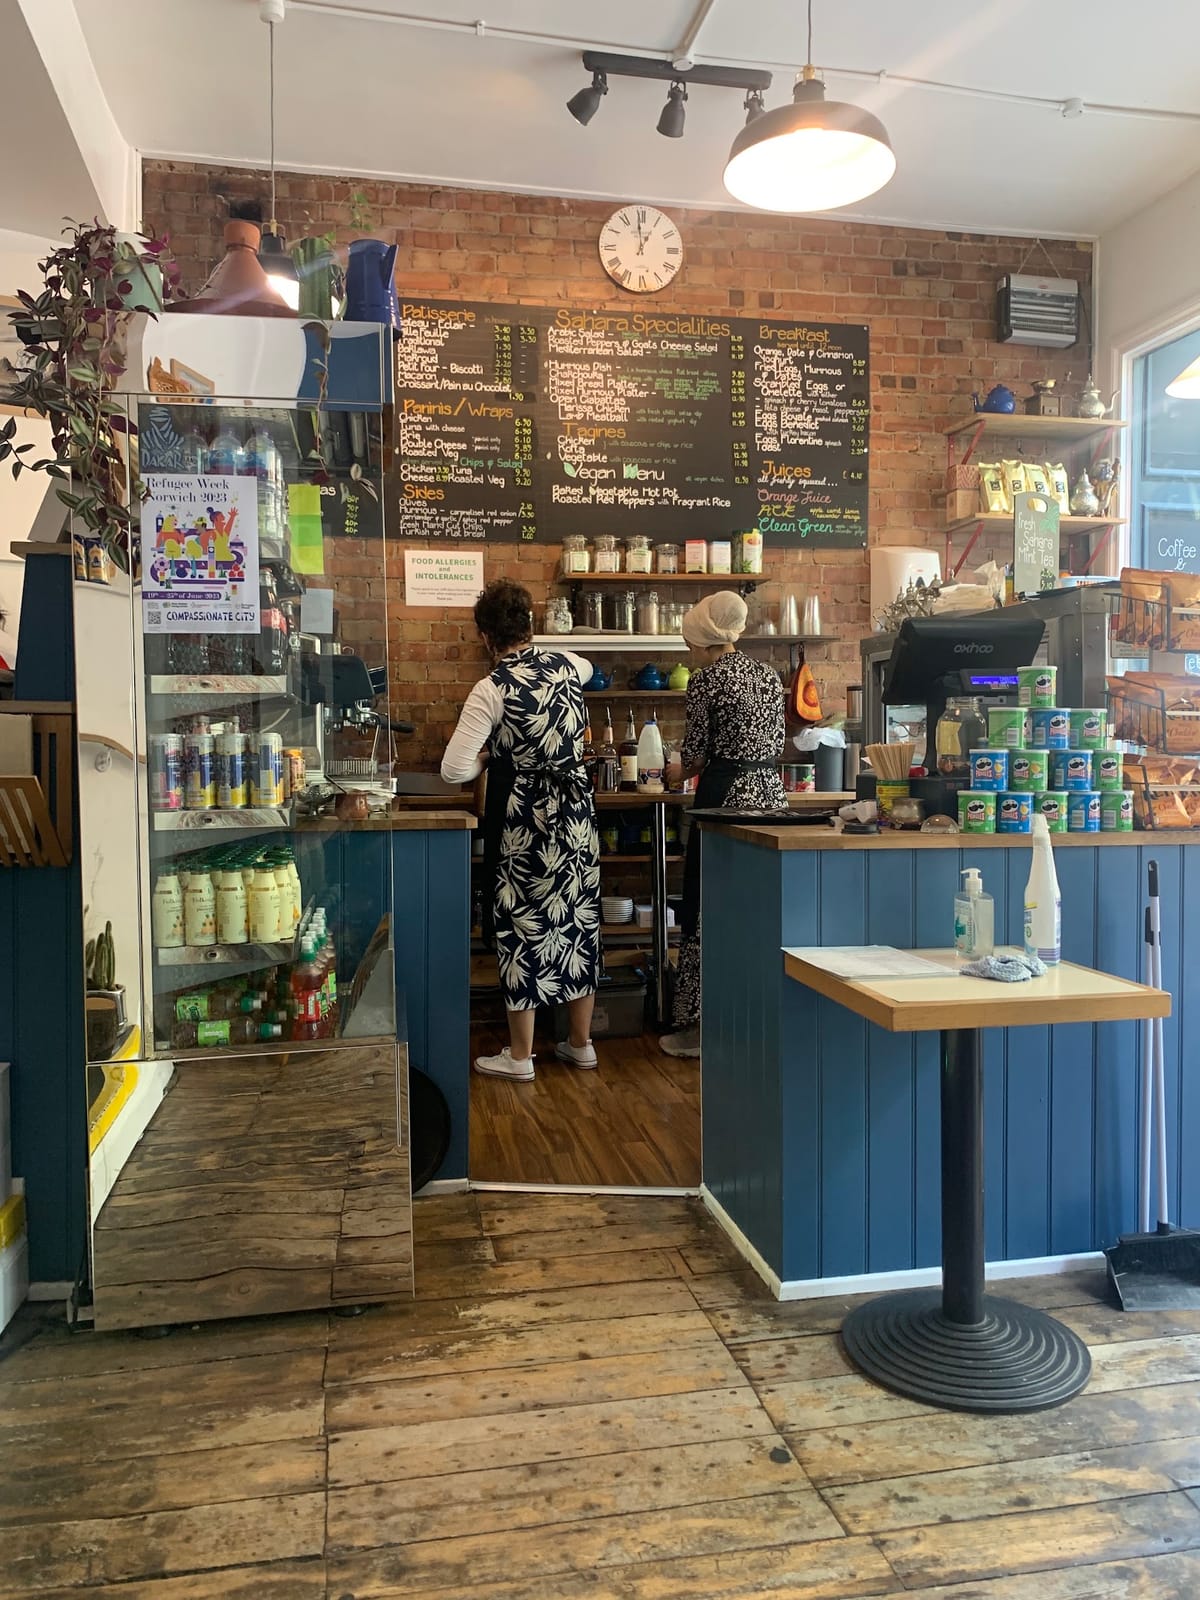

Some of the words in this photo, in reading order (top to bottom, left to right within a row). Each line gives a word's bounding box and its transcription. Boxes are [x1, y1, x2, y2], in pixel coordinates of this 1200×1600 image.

[403, 304, 476, 321] Patisserie
[438, 319, 466, 330] Eclair
[556, 309, 629, 330] Sahara
[632, 315, 731, 336] Specialities
[548, 327, 577, 336] Arabic
[578, 328, 605, 338] Salad
[760, 325, 830, 343] Breakfast
[549, 335, 583, 345] Roasted
[587, 338, 619, 348] Peppers
[632, 340, 657, 350] Goats
[661, 341, 692, 352] Cheese
[694, 343, 718, 352] Salad
[617, 347, 643, 356] Salad
[787, 348, 805, 357] Date
[816, 349, 854, 360] Cinnamon
[398, 362, 419, 372] Petit
[450, 364, 484, 374] Biscotti
[593, 362, 612, 371] Dish
[755, 362, 776, 372] Fried
[475, 383, 512, 393] Chocolat
[549, 378, 575, 386] Mixed
[578, 379, 604, 388] Bread
[608, 379, 638, 388] Platter
[753, 378, 801, 389] Scrambled
[806, 381, 829, 393] Eggs
[550, 386, 575, 394] Mixed
[617, 389, 649, 398] Platter
[761, 387, 802, 397] Omelette
[580, 396, 626, 405] Ciabattas
[596, 405, 630, 413] Chicken
[755, 409, 777, 420] Eggs
[399, 412, 432, 423] Chicken
[587, 413, 628, 422] Meatball
[400, 422, 422, 431] Tuna
[442, 425, 465, 433] cheese
[755, 419, 777, 431] Eggs
[781, 420, 819, 429] Benedict
[401, 430, 421, 440] Brie
[563, 423, 626, 440] Tagines
[401, 438, 432, 449] Double
[434, 439, 467, 450] Cheese
[558, 436, 595, 445] Chicken
[755, 433, 777, 444] Eggs
[781, 435, 823, 445] Florentine
[757, 443, 781, 451] Toast
[401, 447, 437, 457] Roasted
[441, 449, 459, 461] Veg
[559, 453, 608, 465] Vegetable
[460, 457, 484, 468] Chips
[497, 458, 523, 468] Salad
[401, 464, 437, 473] Chicken
[450, 465, 472, 474] Tuna
[564, 462, 616, 486] Vegan
[623, 463, 665, 481] Menu
[762, 461, 812, 478] Juices
[147, 477, 193, 491] Refugee
[198, 478, 229, 490] Week
[401, 473, 435, 482] Cheese
[448, 473, 484, 484] Roasted
[488, 475, 505, 488] Veg
[403, 484, 445, 499] Sides
[553, 485, 584, 495] Baked
[589, 487, 638, 497] Vegetable
[643, 487, 660, 497] Hot
[758, 488, 799, 506] Orange
[801, 491, 832, 505] Juice
[200, 493, 227, 503] 2023
[553, 493, 592, 503] Roasted
[618, 496, 654, 509] Peppers
[673, 498, 711, 509] Fragrant
[712, 497, 731, 507] Rice
[464, 529, 485, 537] bread
[758, 517, 796, 532] Clean
[797, 518, 834, 538] Green
[1023, 531, 1053, 550] Sahara
[1159, 538, 1197, 558] Coffee
[1018, 547, 1037, 564] Mint
[1038, 550, 1054, 567] Tea
